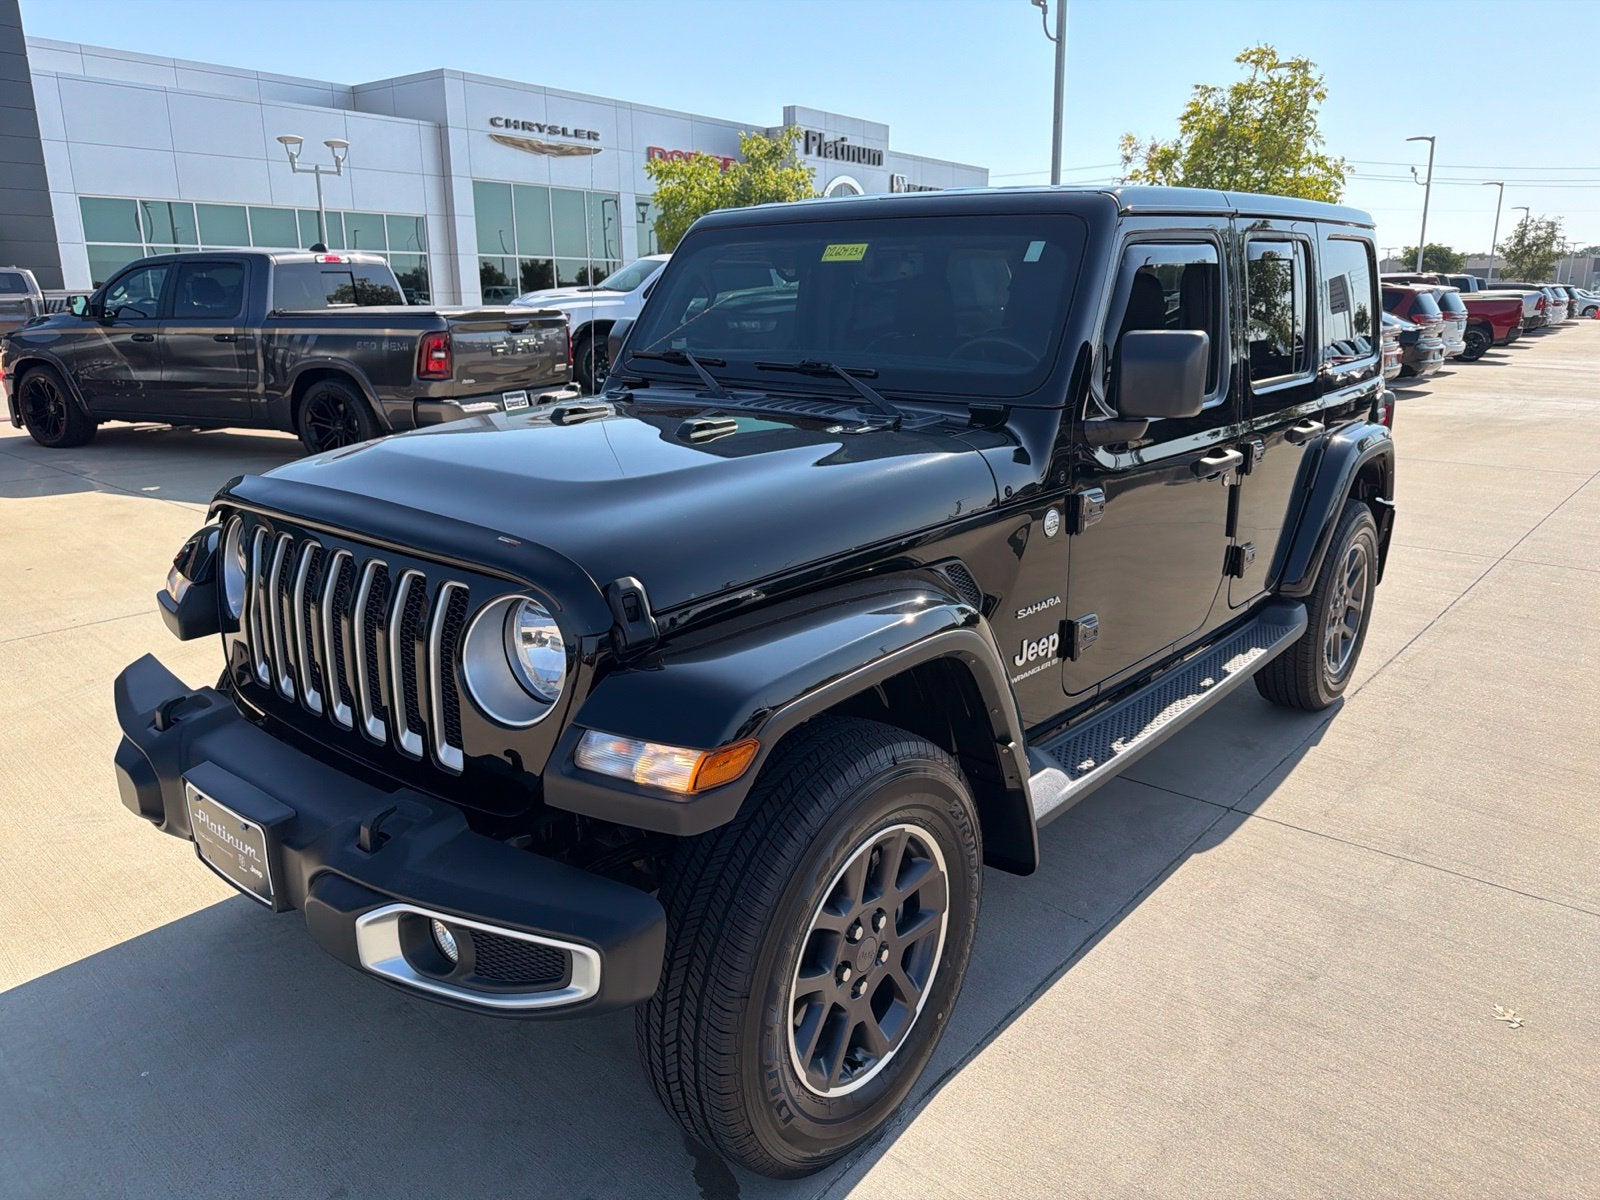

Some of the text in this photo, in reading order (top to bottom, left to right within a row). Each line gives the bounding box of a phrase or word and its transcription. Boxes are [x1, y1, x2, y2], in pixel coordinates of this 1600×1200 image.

[489, 116, 601, 141] CHRYSLER
[804, 129, 884, 167] Platinum
[381, 340, 409, 352] HEMI
[1015, 596, 1061, 620] SAHARA
[1013, 633, 1060, 667] Jeep
[1011, 661, 1051, 684] WRANGLER
[194, 808, 262, 863] Platinum
